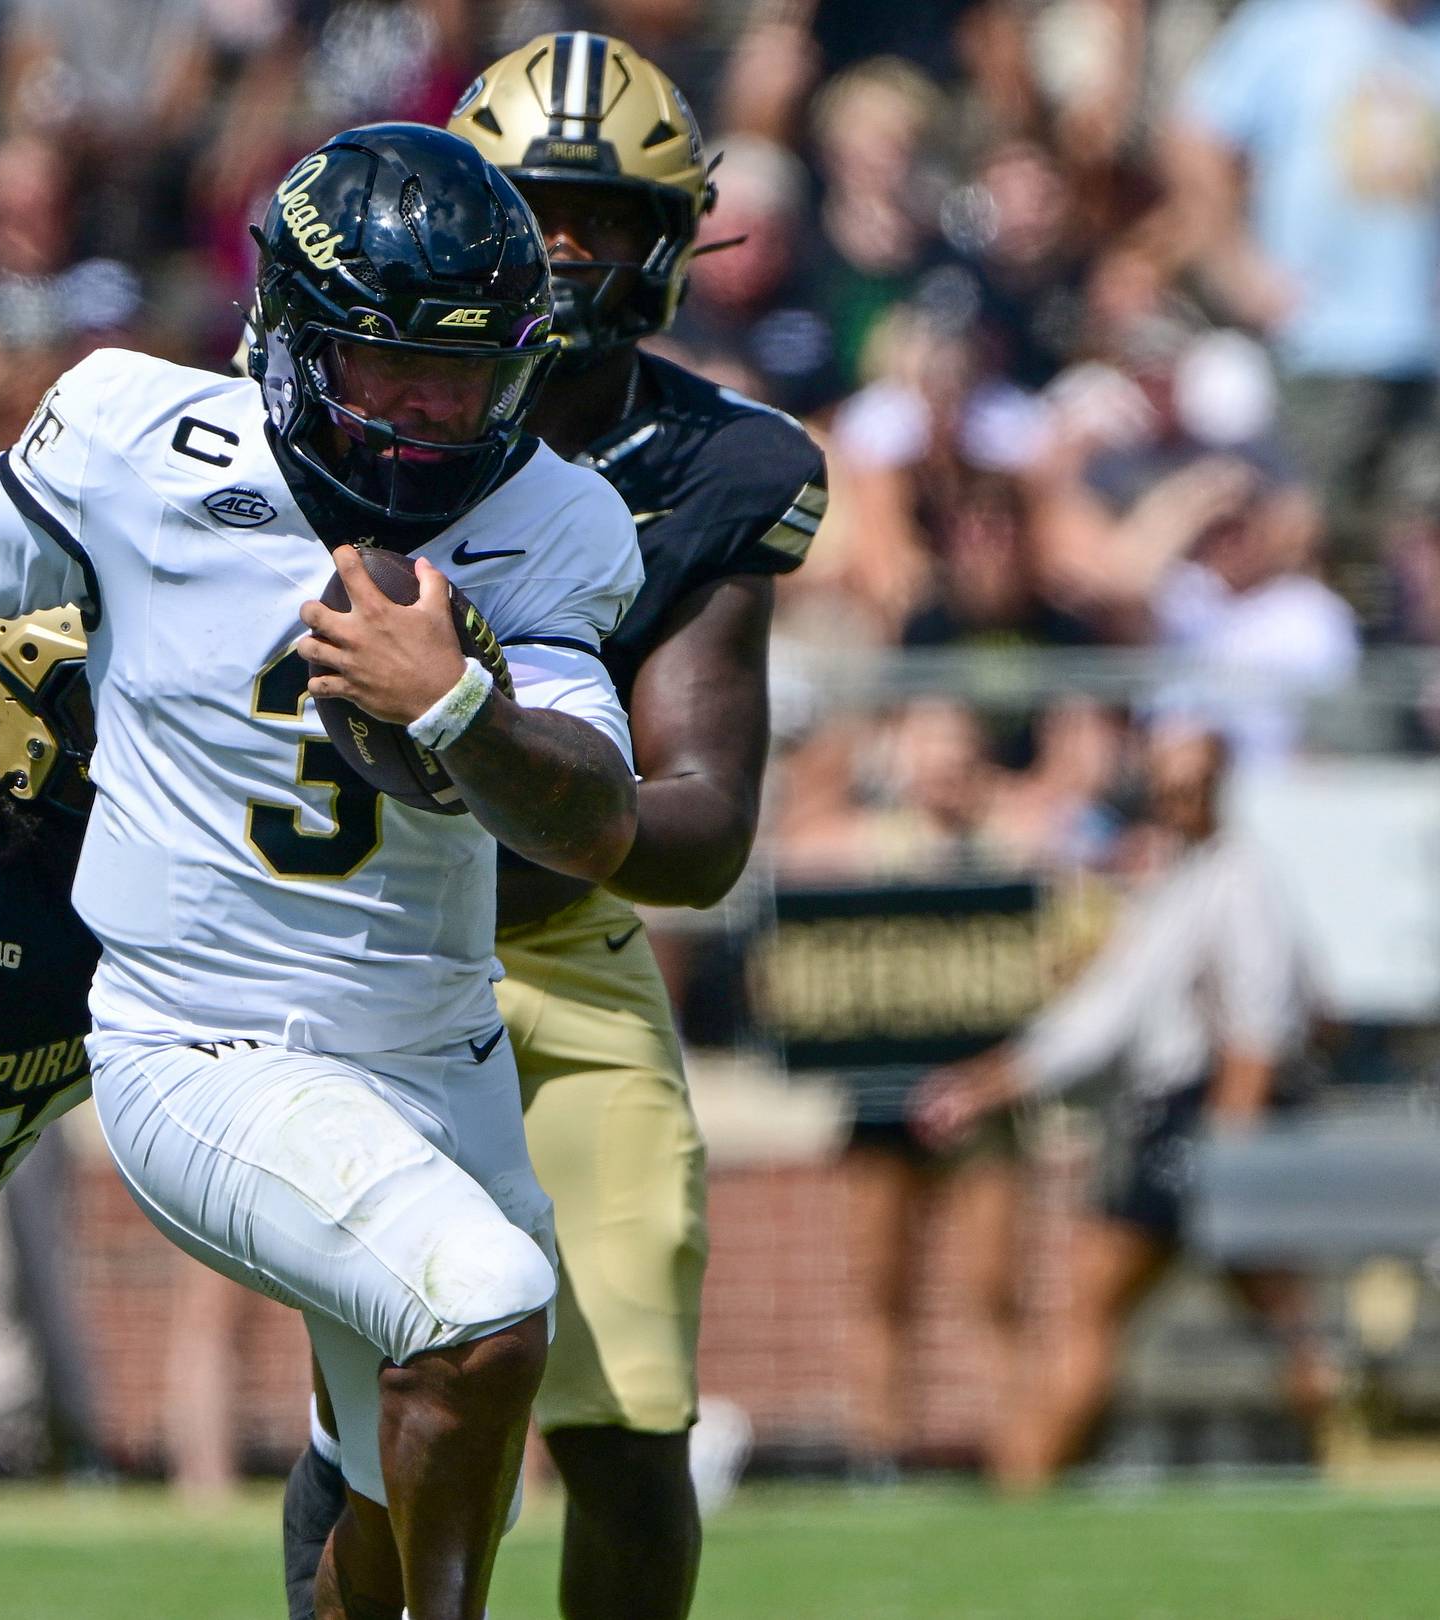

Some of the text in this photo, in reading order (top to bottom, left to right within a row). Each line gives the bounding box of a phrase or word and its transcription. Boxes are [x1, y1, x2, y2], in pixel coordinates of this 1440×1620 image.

[278, 154, 343, 270] Deacs
[437, 308, 491, 327] ACC
[172, 416, 240, 468] C
[213, 496, 268, 519] ACC
[244, 634, 384, 881] 3
